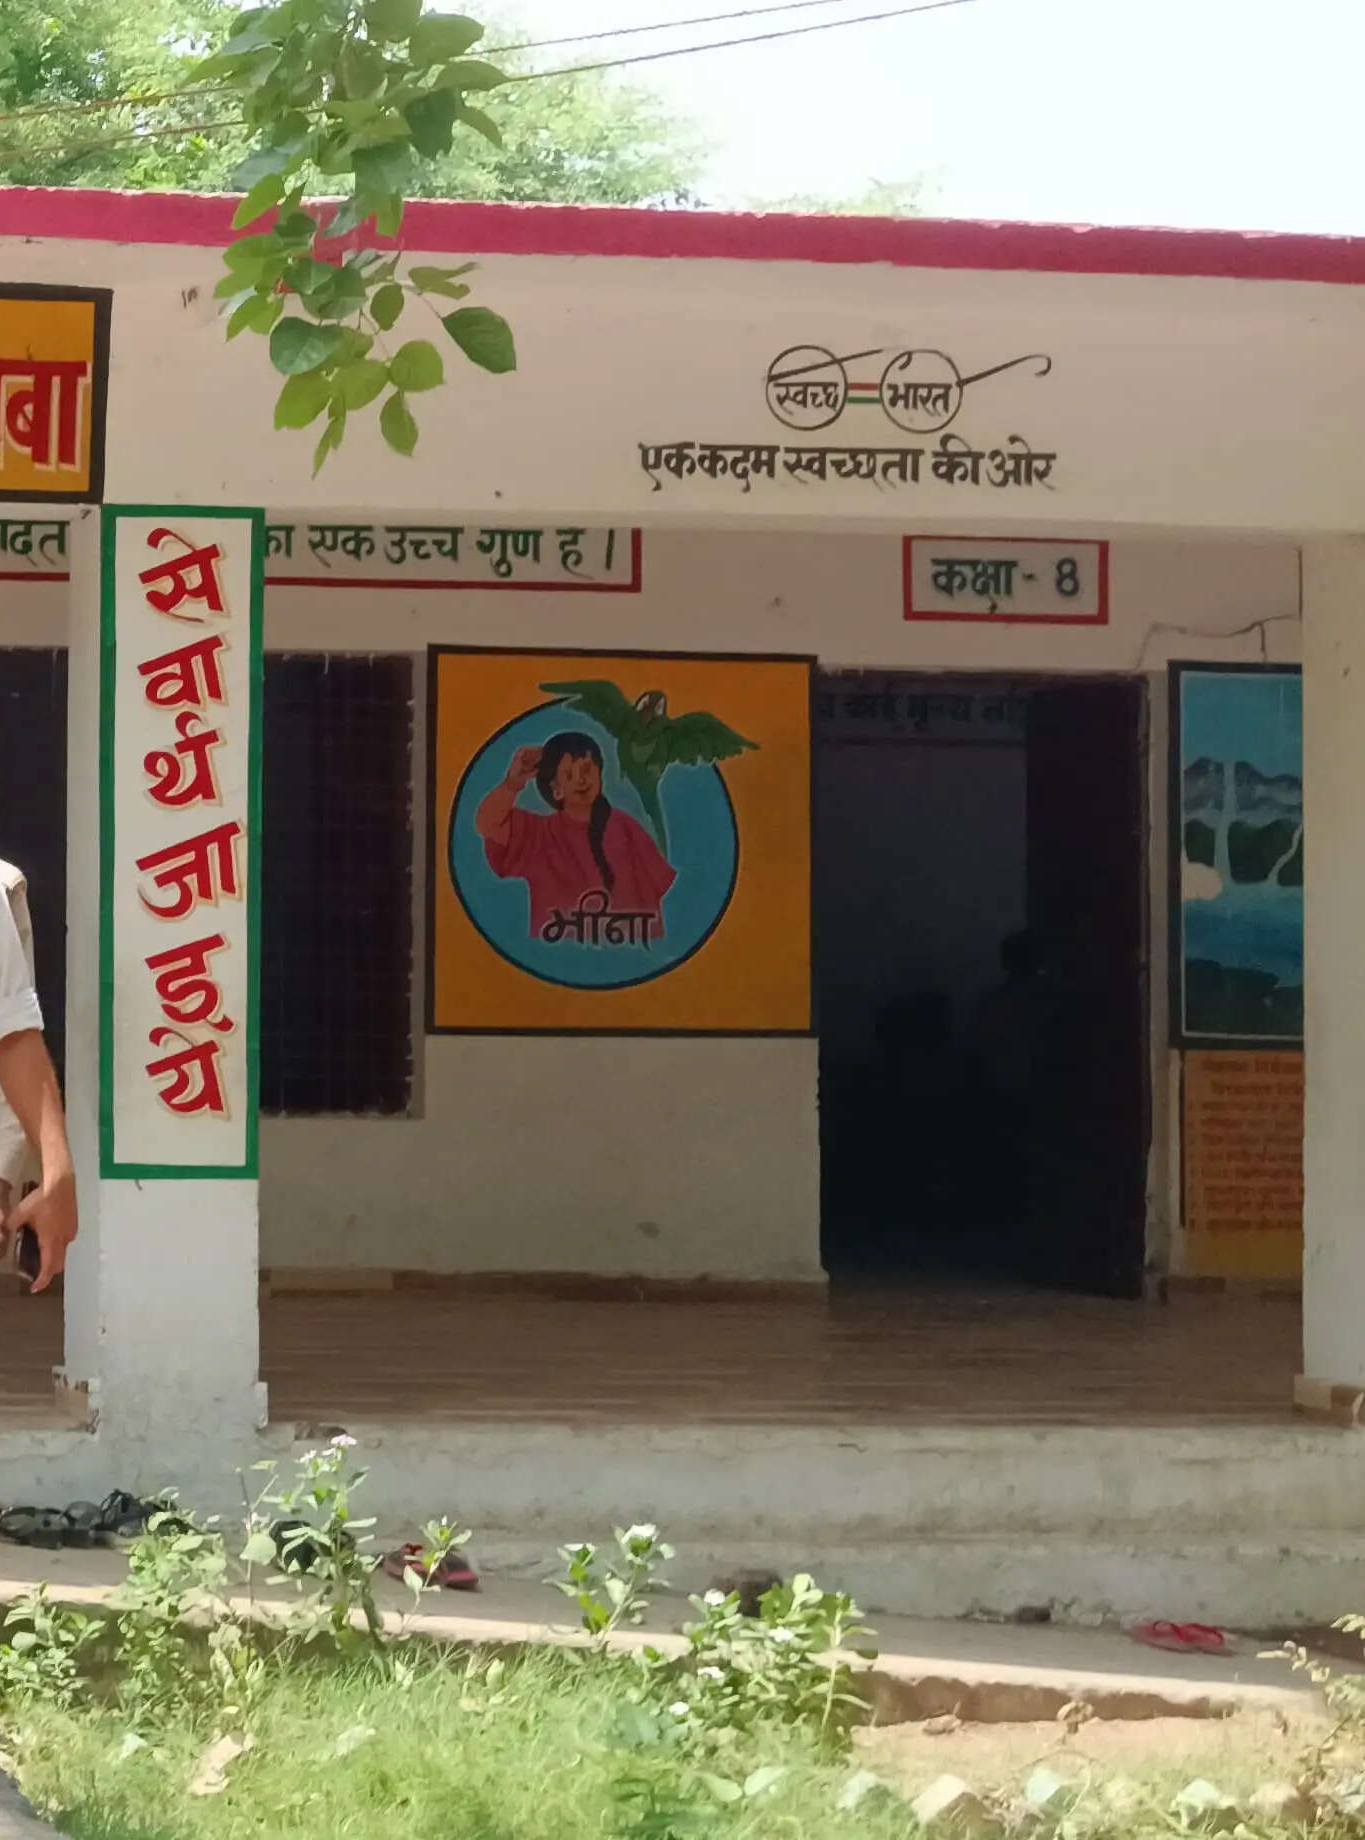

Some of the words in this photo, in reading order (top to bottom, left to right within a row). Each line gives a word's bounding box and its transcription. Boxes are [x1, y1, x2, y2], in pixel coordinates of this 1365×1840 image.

[772, 382, 840, 416] स्वच्छ
[885, 382, 952, 417] भारत
[782, 446, 925, 491] स्वच्छता
[932, 433, 985, 487] की
[985, 435, 1058, 490] ओर
[383, 525, 465, 565] उच्च
[475, 528, 545, 578] गुण
